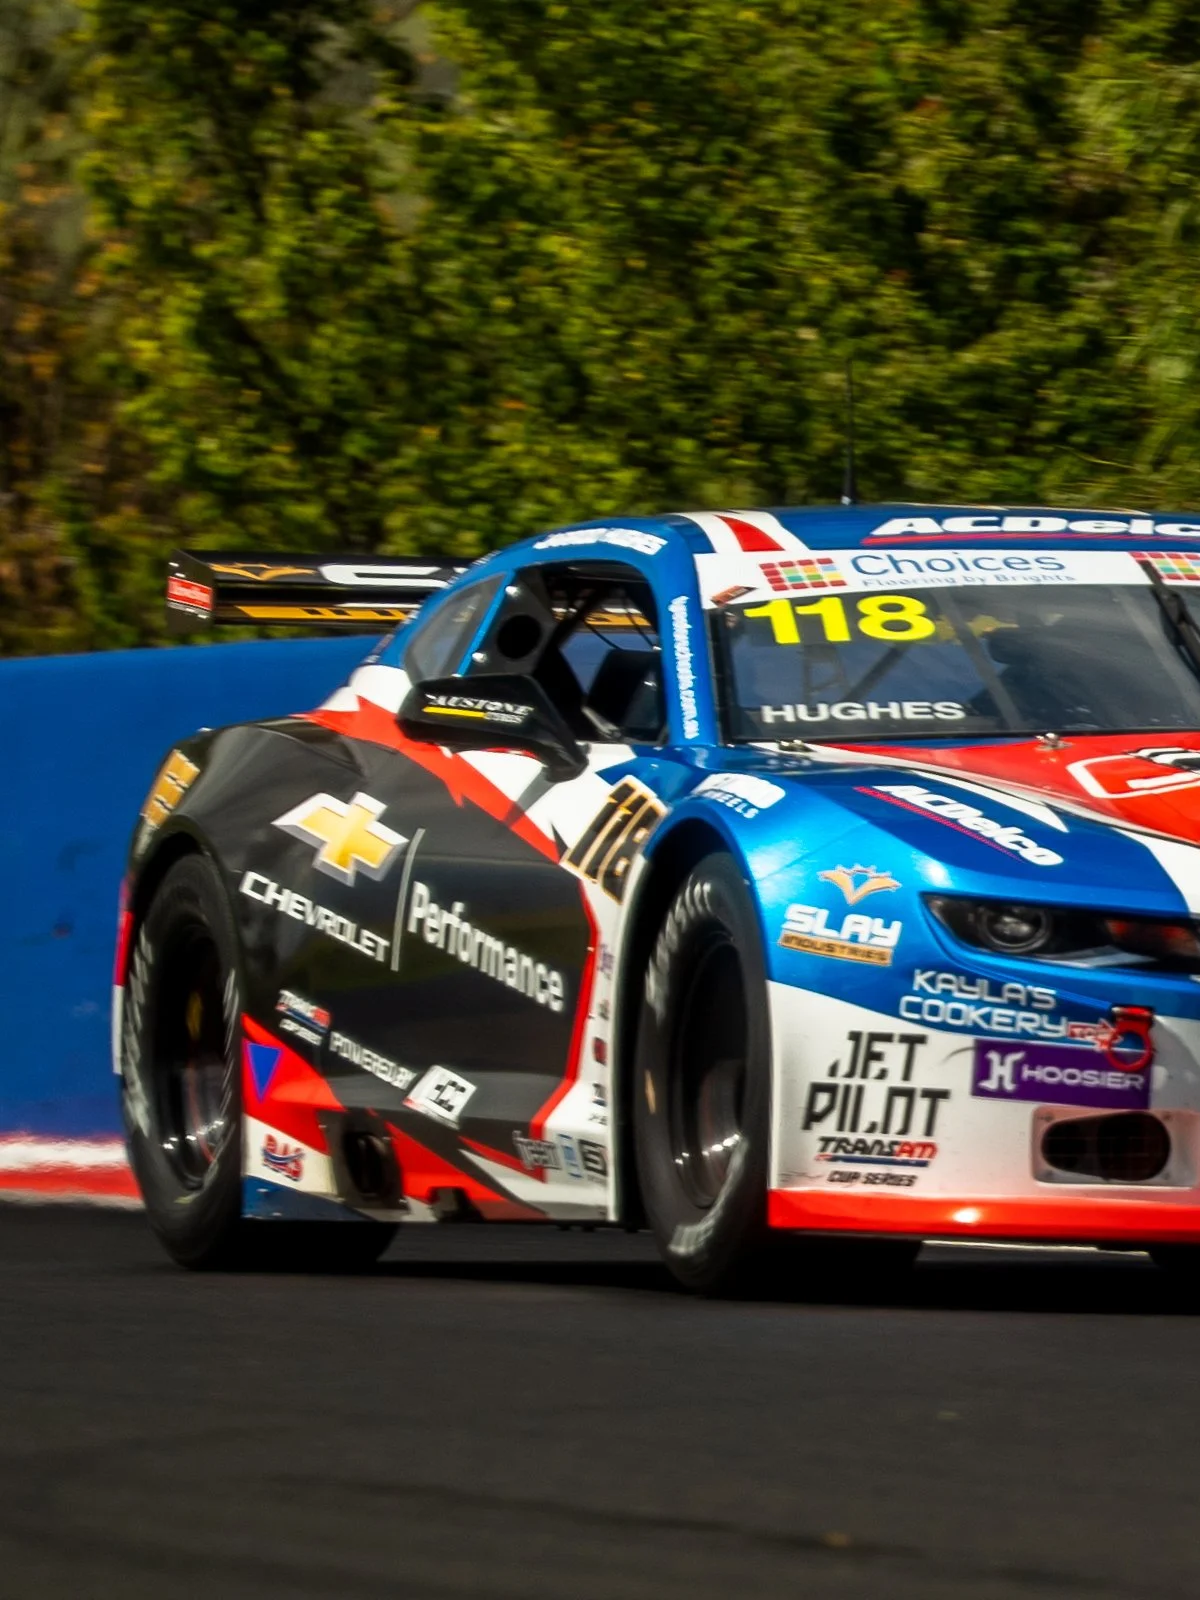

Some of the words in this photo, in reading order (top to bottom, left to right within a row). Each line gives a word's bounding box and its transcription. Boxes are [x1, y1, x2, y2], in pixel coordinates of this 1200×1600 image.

[851, 551, 1066, 575] Choices
[862, 575, 957, 587] Flooring
[963, 574, 986, 586] by
[993, 573, 1077, 583] Brights
[743, 595, 936, 644] 118
[761, 701, 966, 723] HUGHES
[871, 785, 1064, 865] ACDelco
[239, 871, 390, 962] CHEVROLET
[781, 903, 902, 948] SLAY
[407, 880, 564, 1012] Performance
[912, 968, 1057, 1010] KAYLA'S
[899, 995, 1067, 1038] COOKERY
[827, 1030, 929, 1082] JET
[1020, 1063, 1145, 1090] HOOSIER
[801, 1082, 952, 1137] PILOT
